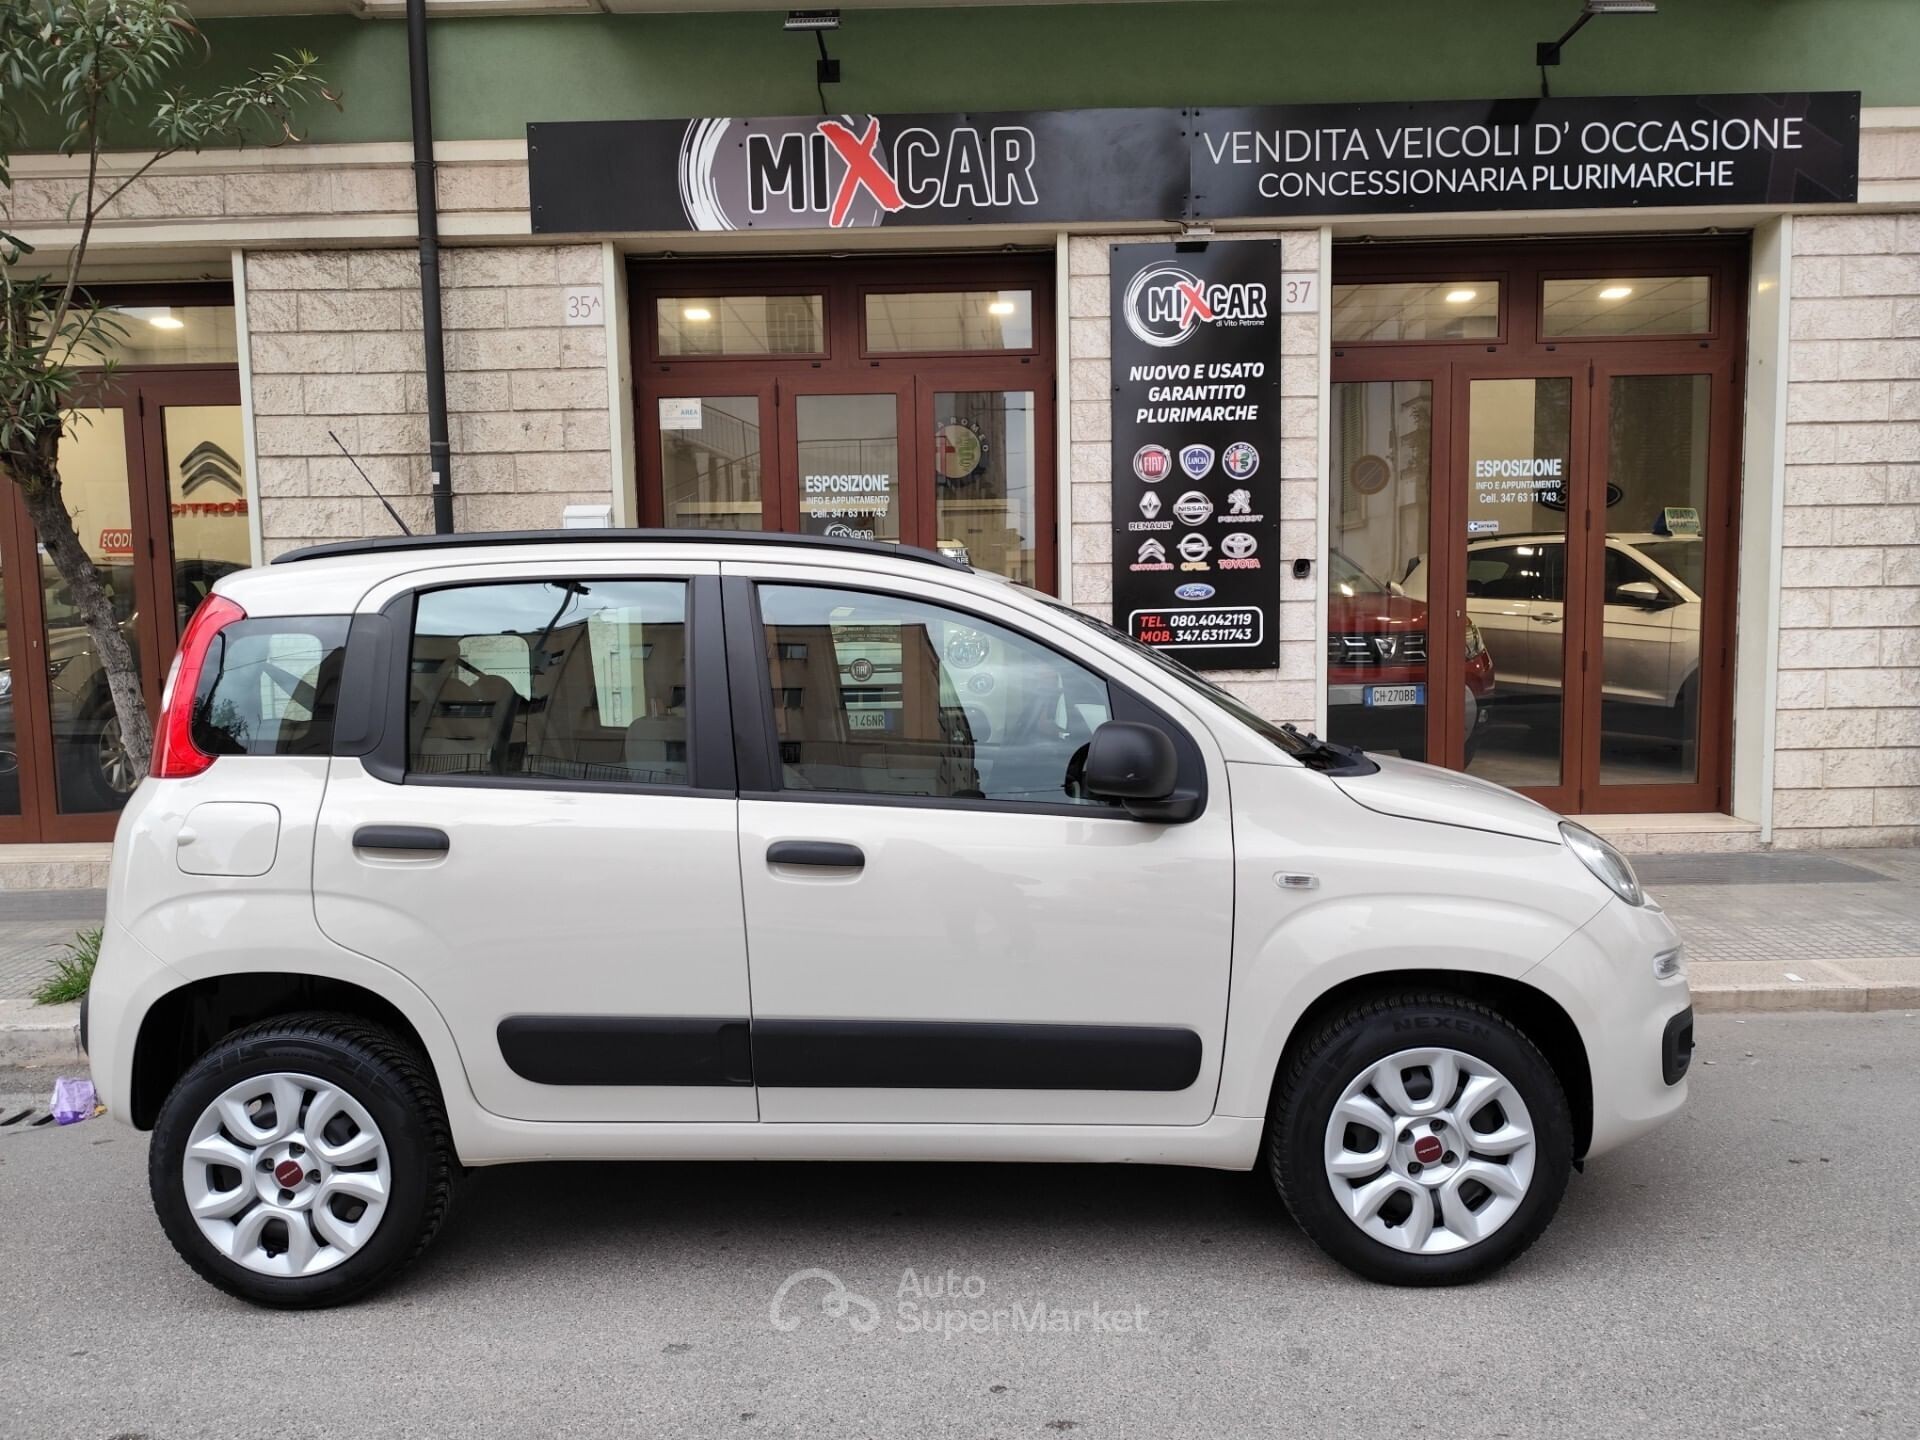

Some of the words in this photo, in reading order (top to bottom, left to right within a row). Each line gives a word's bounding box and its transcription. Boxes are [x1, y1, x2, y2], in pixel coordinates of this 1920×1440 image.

[1204, 128, 1370, 164] VENDITA
[1375, 125, 1520, 160] VEICOLI
[1580, 117, 1804, 154] OCCASIONE
[746, 117, 1039, 228] MIXCAR
[1258, 168, 1527, 199] CONCESSIONARIA
[1532, 160, 1735, 192] PLURIMARCHE
[1286, 281, 1312, 304] 37
[1148, 279, 1267, 329] MIXCAR
[1216, 319, 1222, 327] di
[1223, 319, 1238, 327] Vito
[1239, 318, 1265, 327] Petrone
[1129, 364, 1190, 381] NUOVO
[1193, 363, 1204, 379] E
[1208, 362, 1265, 378] USATO
[1148, 384, 1246, 402] GARANTITO
[1136, 404, 1259, 423] PLURIMARCHE
[1143, 456, 1163, 473] FIAT
[1187, 456, 1208, 466] LANCIA
[1475, 459, 1562, 477] ESPOSIZIONE
[805, 474, 890, 492] ESPOSIZIONE
[1475, 482, 1493, 490] INFO
[1495, 481, 1500, 489] E
[1501, 479, 1561, 489] APPUNTAMENTO
[806, 496, 823, 505] INFO
[825, 496, 830, 504] E
[831, 495, 890, 505] APPUNTAMENTO
[1480, 493, 1498, 503] Cell.
[1500, 493, 1516, 502] 347
[1517, 493, 1528, 502] 63
[1529, 493, 1539, 502] 11
[1541, 492, 1557, 502] 743
[811, 508, 829, 518] Cell.
[831, 508, 846, 518] 347
[847, 508, 858, 518] 63
[861, 508, 869, 517] 11
[871, 507, 886, 518] 743
[1178, 505, 1209, 513] NISSAN
[1128, 521, 1174, 531] RENAULT
[102, 532, 133, 548] ECODI
[1218, 558, 1261, 570] TOYOTA
[1183, 585, 1207, 598] Ford
[1140, 616, 1166, 627] TEL.
[1170, 614, 1251, 627] 080.4042119
[1140, 631, 1173, 642] MOB.
[1175, 629, 1252, 642] 347.6311743
[856, 665, 868, 675] FIAT
[1393, 1016, 1490, 1041] NEXEN
